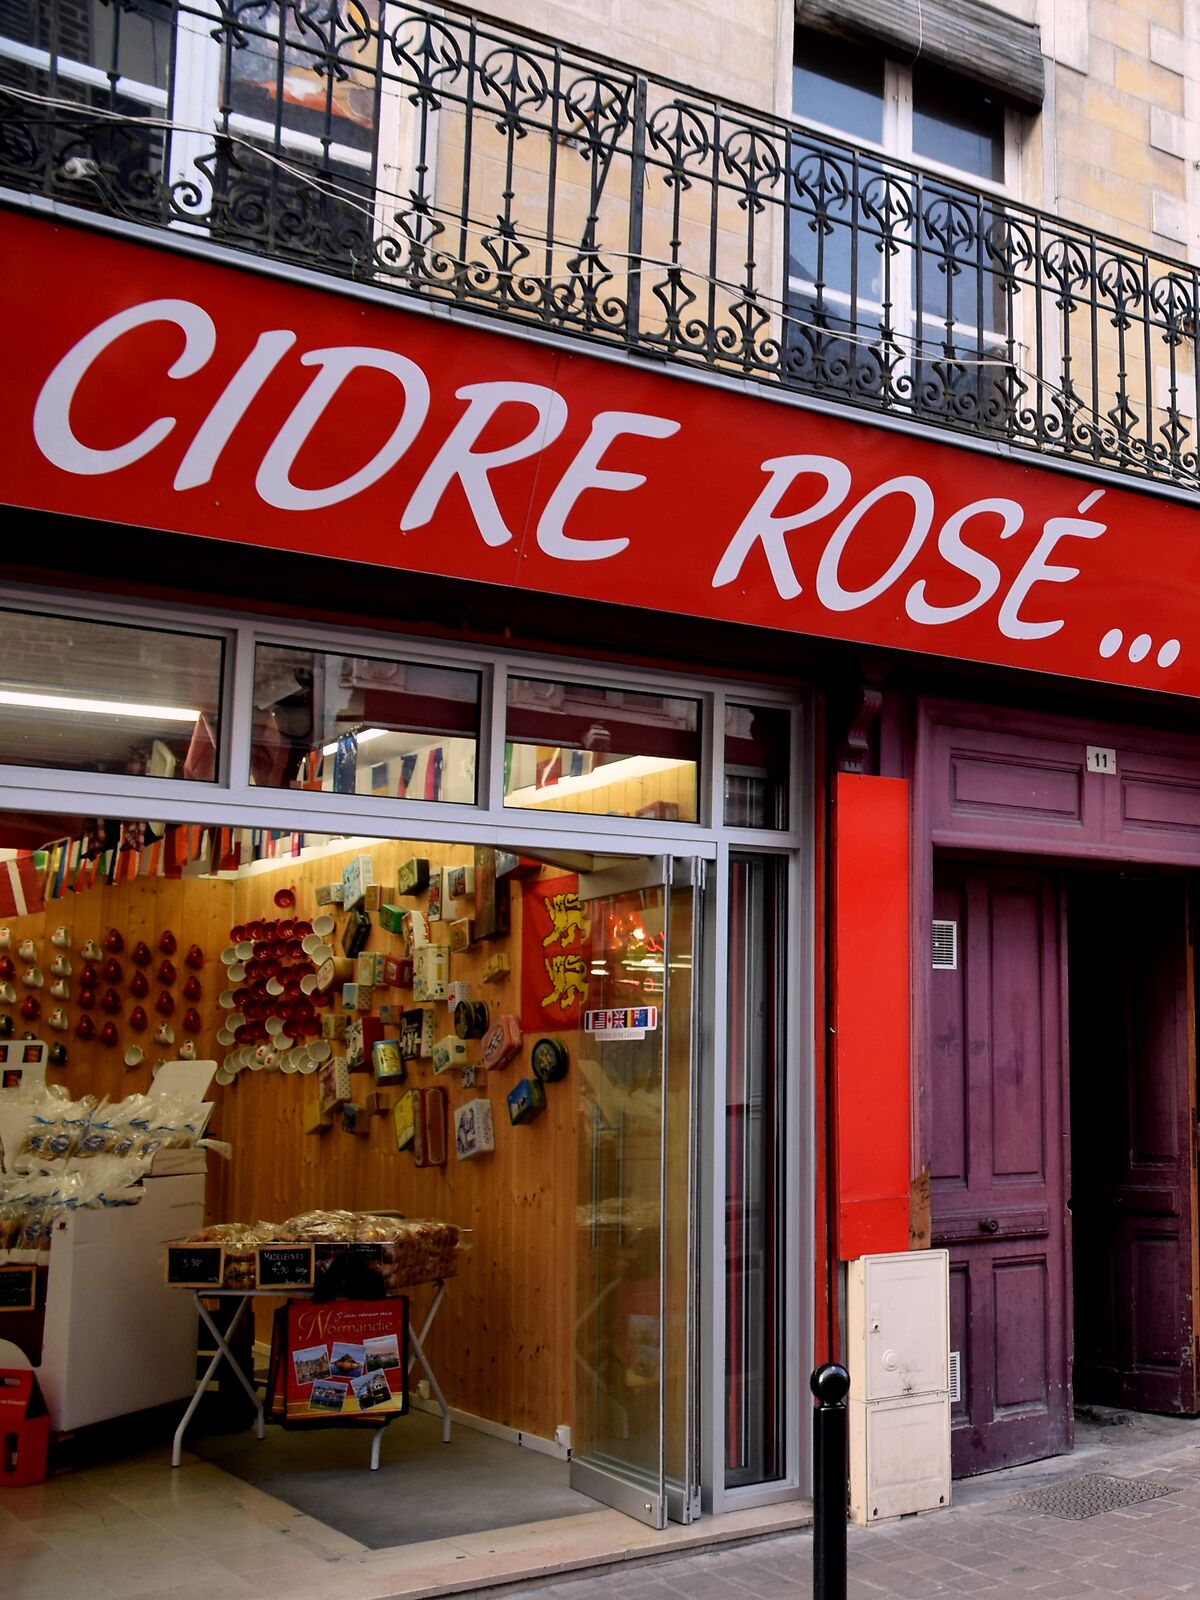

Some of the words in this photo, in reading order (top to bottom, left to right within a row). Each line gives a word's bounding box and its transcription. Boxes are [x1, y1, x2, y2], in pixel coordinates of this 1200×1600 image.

[33, 299, 681, 561] CIDRE
[712, 454, 1108, 640] ROSÉ
[1095, 753, 1107, 768] 11
[263, 1253, 304, 1261] MADELEINES
[298, 1309, 394, 1342] Normandie
